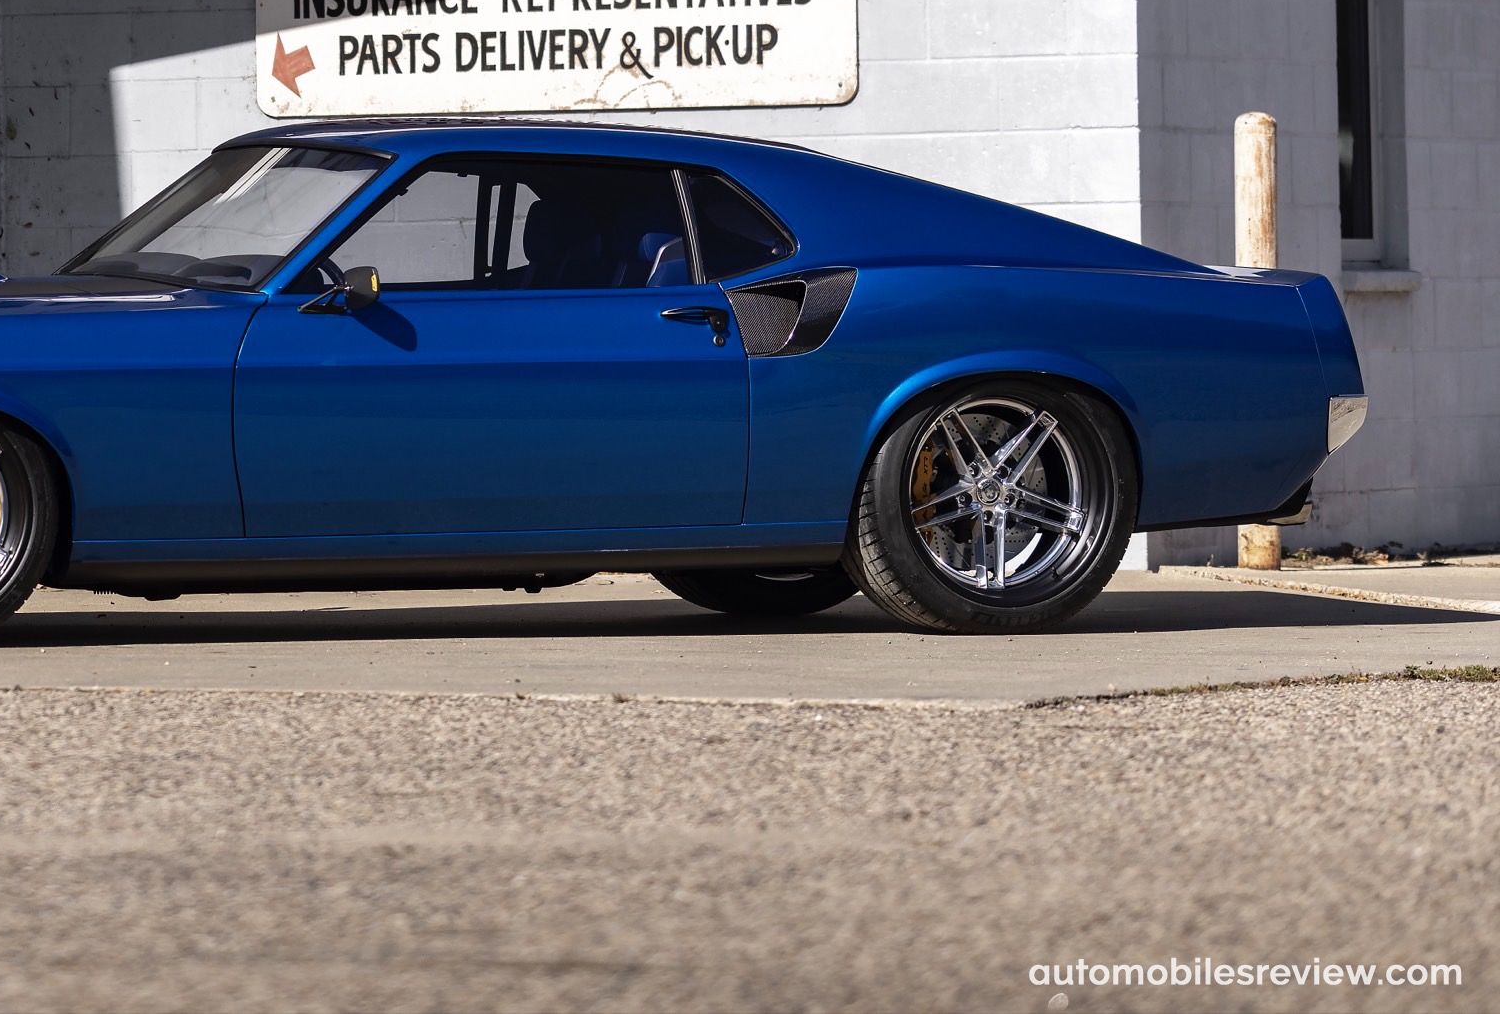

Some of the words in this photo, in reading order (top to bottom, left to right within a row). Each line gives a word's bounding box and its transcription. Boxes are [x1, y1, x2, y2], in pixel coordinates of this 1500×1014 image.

[338, 32, 441, 76] PARTS
[455, 27, 611, 74] DELIVERY
[619, 32, 654, 80] &
